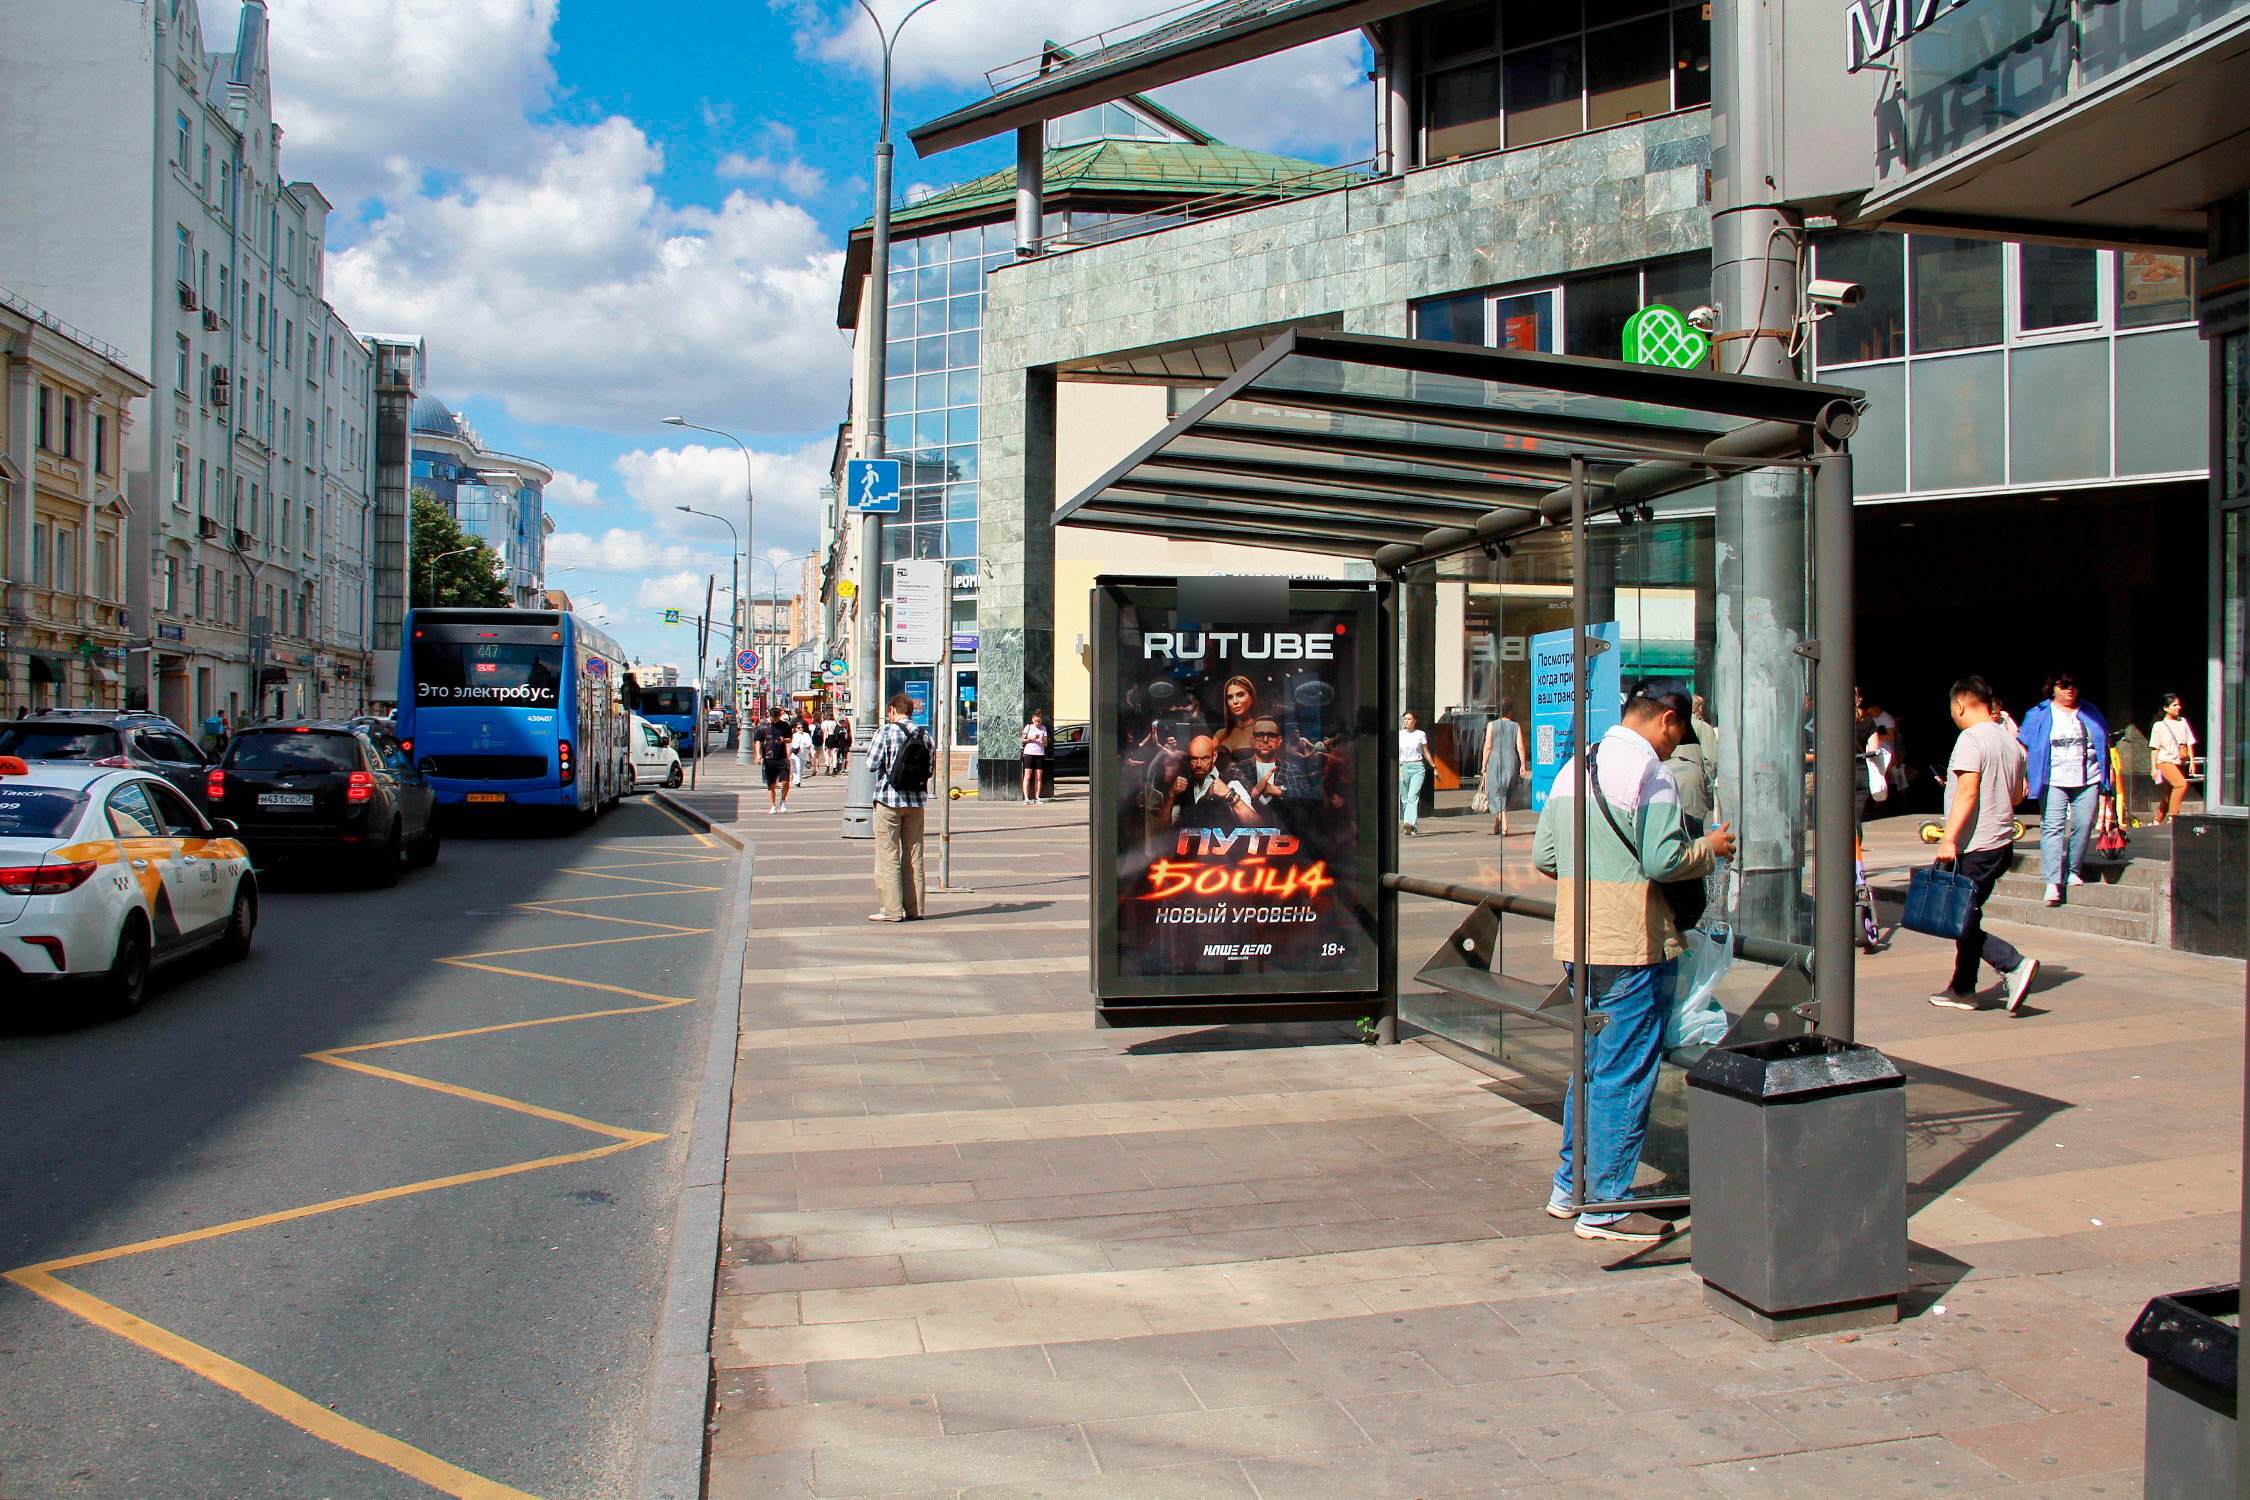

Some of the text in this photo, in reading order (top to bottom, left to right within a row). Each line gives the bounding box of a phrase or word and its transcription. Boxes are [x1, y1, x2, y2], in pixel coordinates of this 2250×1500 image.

[478, 645, 499, 658] 447
[1144, 632, 1334, 660] RUTUBE
[1538, 673, 1558, 687] когда
[418, 683, 555, 701] Это электробус.
[1538, 693, 1553, 705] ваш
[2, 789, 44, 797] Такси
[1176, 827, 1300, 856] ПУТЬ
[1155, 902, 1318, 924] НОВЫЙ УРОВЕНЬ
[1203, 943, 1272, 956] НАШЕ ДЕЛО
[1321, 942, 1346, 956] 18+
